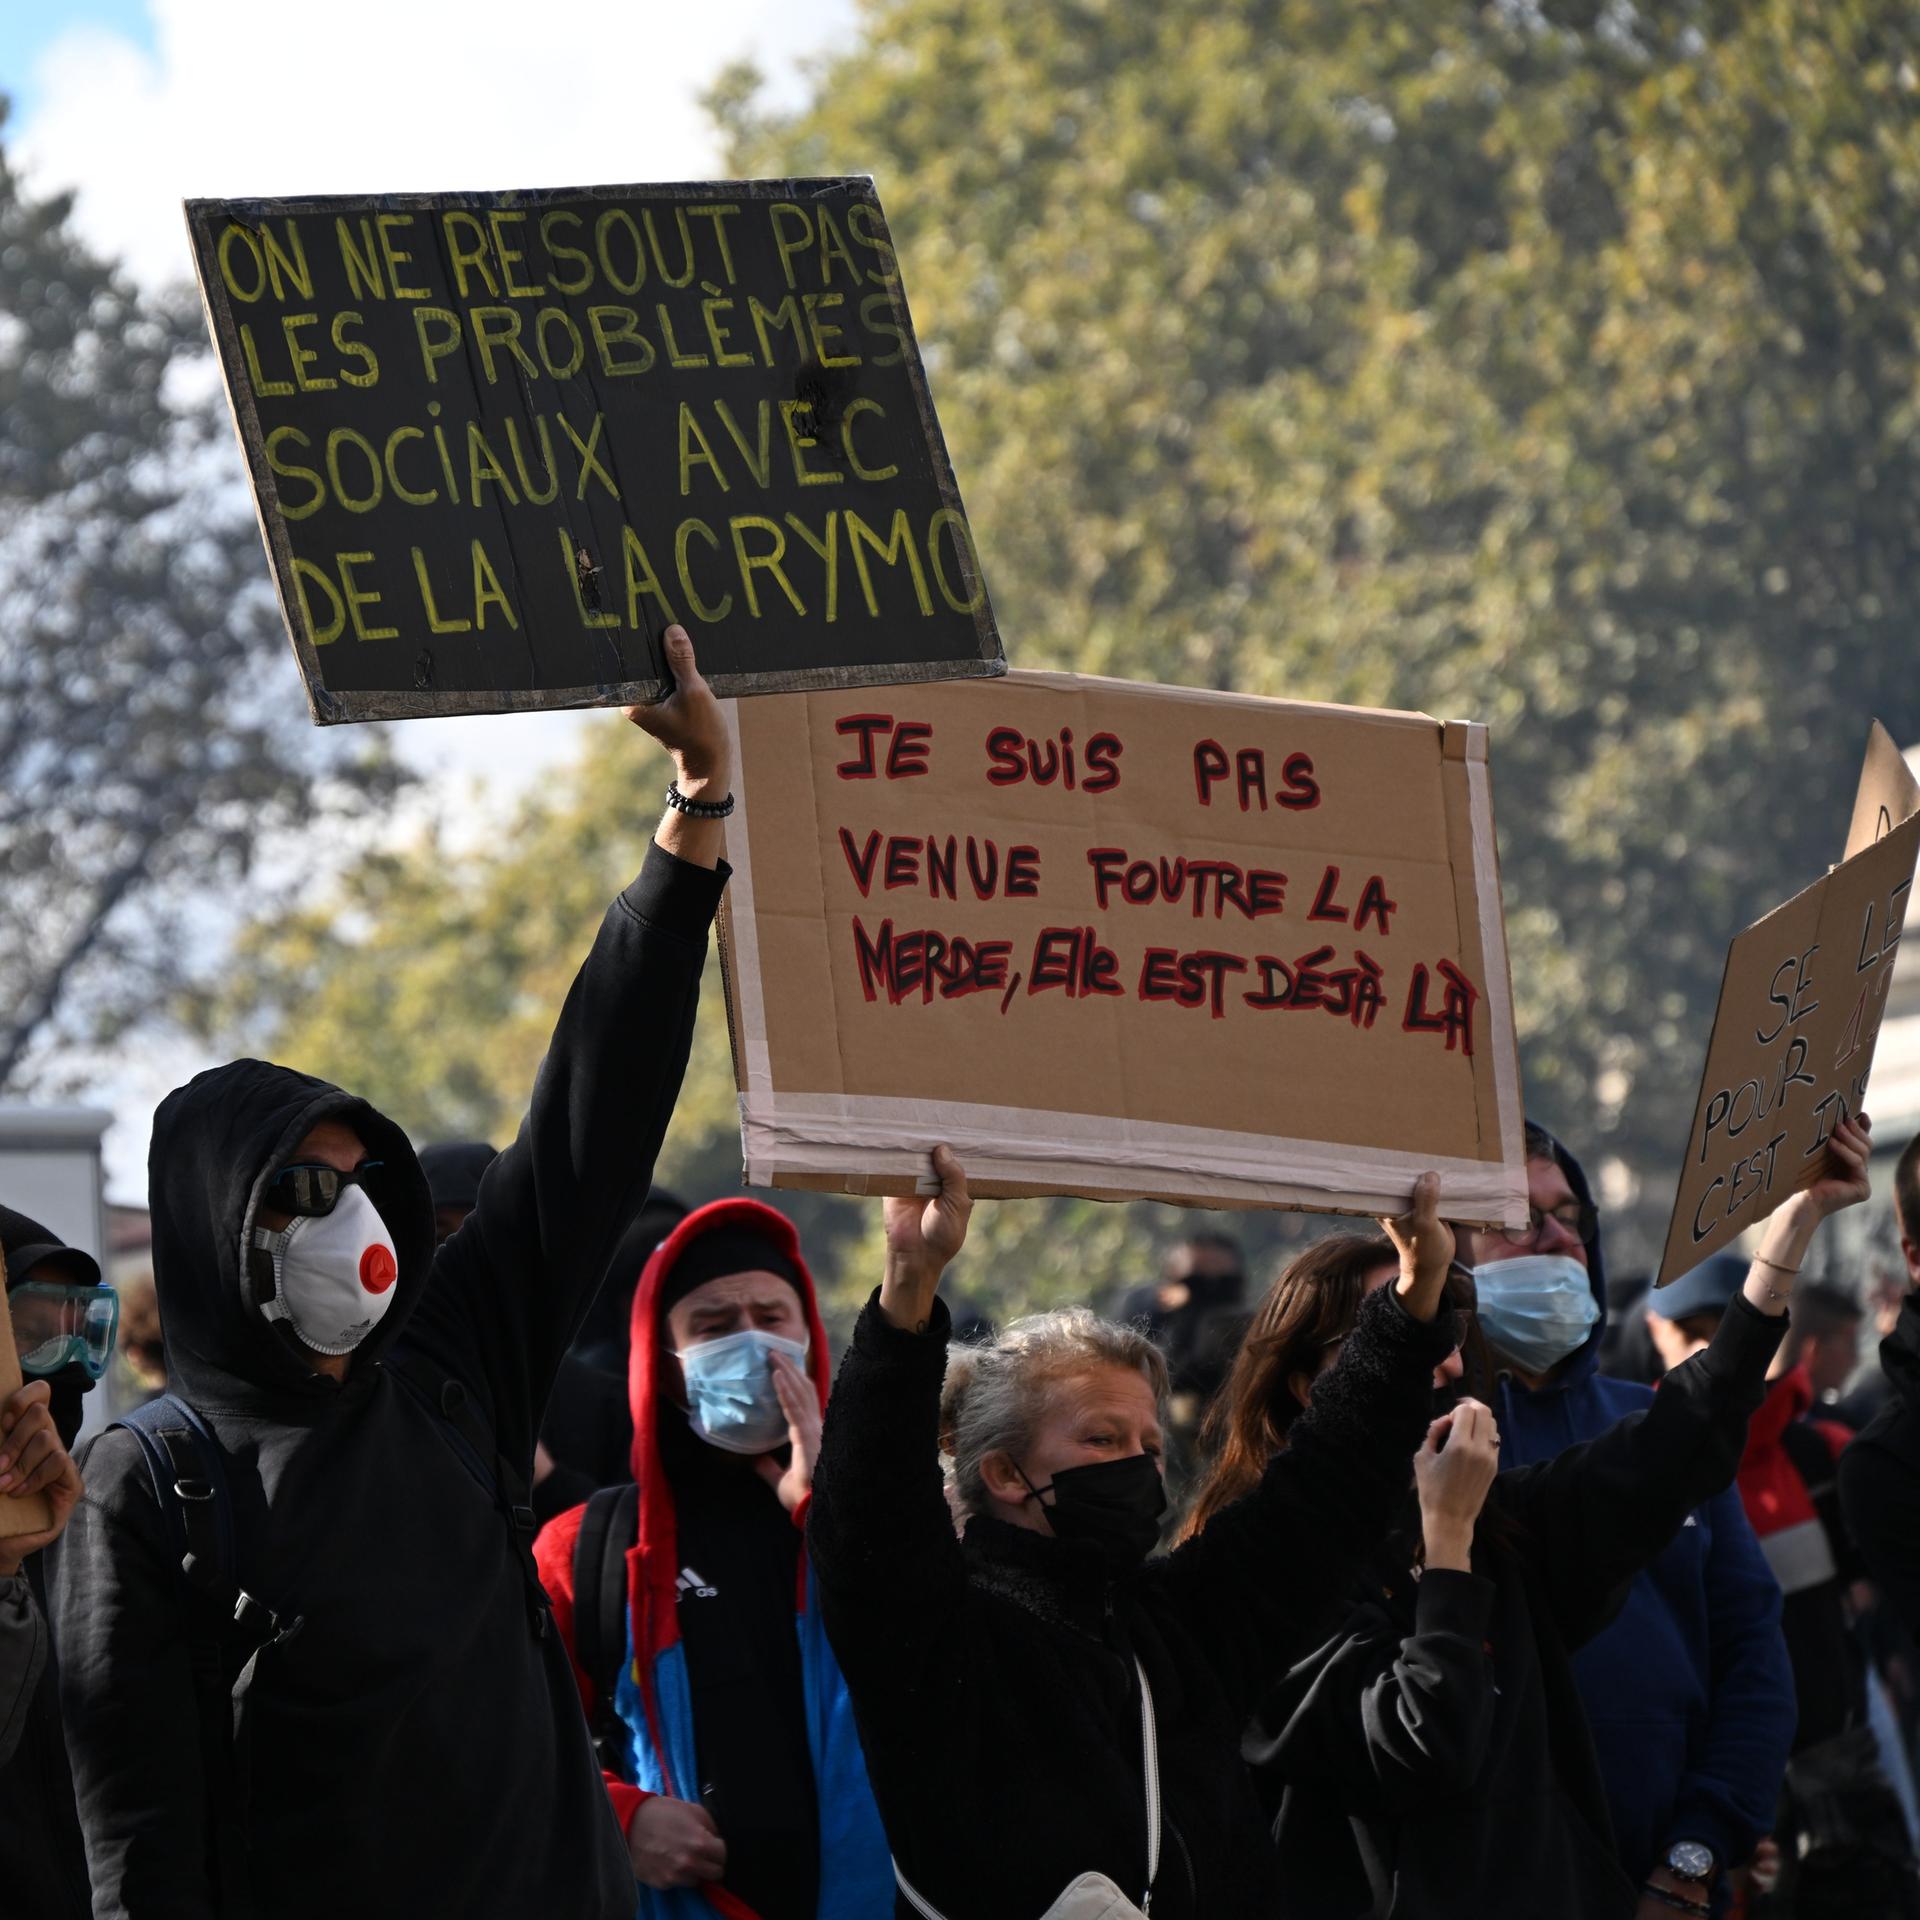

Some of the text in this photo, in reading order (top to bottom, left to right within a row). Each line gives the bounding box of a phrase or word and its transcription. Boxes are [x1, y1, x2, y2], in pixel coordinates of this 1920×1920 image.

[218, 217, 315, 302] ON
[336, 212, 432, 301] NE
[769, 202, 900, 290] PAS
[240, 281, 911, 397] LES PROBLÈMES
[679, 397, 899, 496] AVEC
[289, 506, 985, 647] DE LA LACRYMO
[835, 713, 933, 780] JE
[1194, 738, 1321, 812] PAS
[838, 826, 1398, 936] VENUE FOUTRE LA
[852, 914, 1022, 1016] MERDE,
[1138, 946, 1249, 1019] EST
[1242, 944, 1388, 1030] DÉJÀ
[1402, 958, 1481, 1056] LÀ
[1755, 944, 1821, 1046] SE
[1700, 1035, 1817, 1167] POUR
[1692, 1130, 1789, 1245] C'EST
